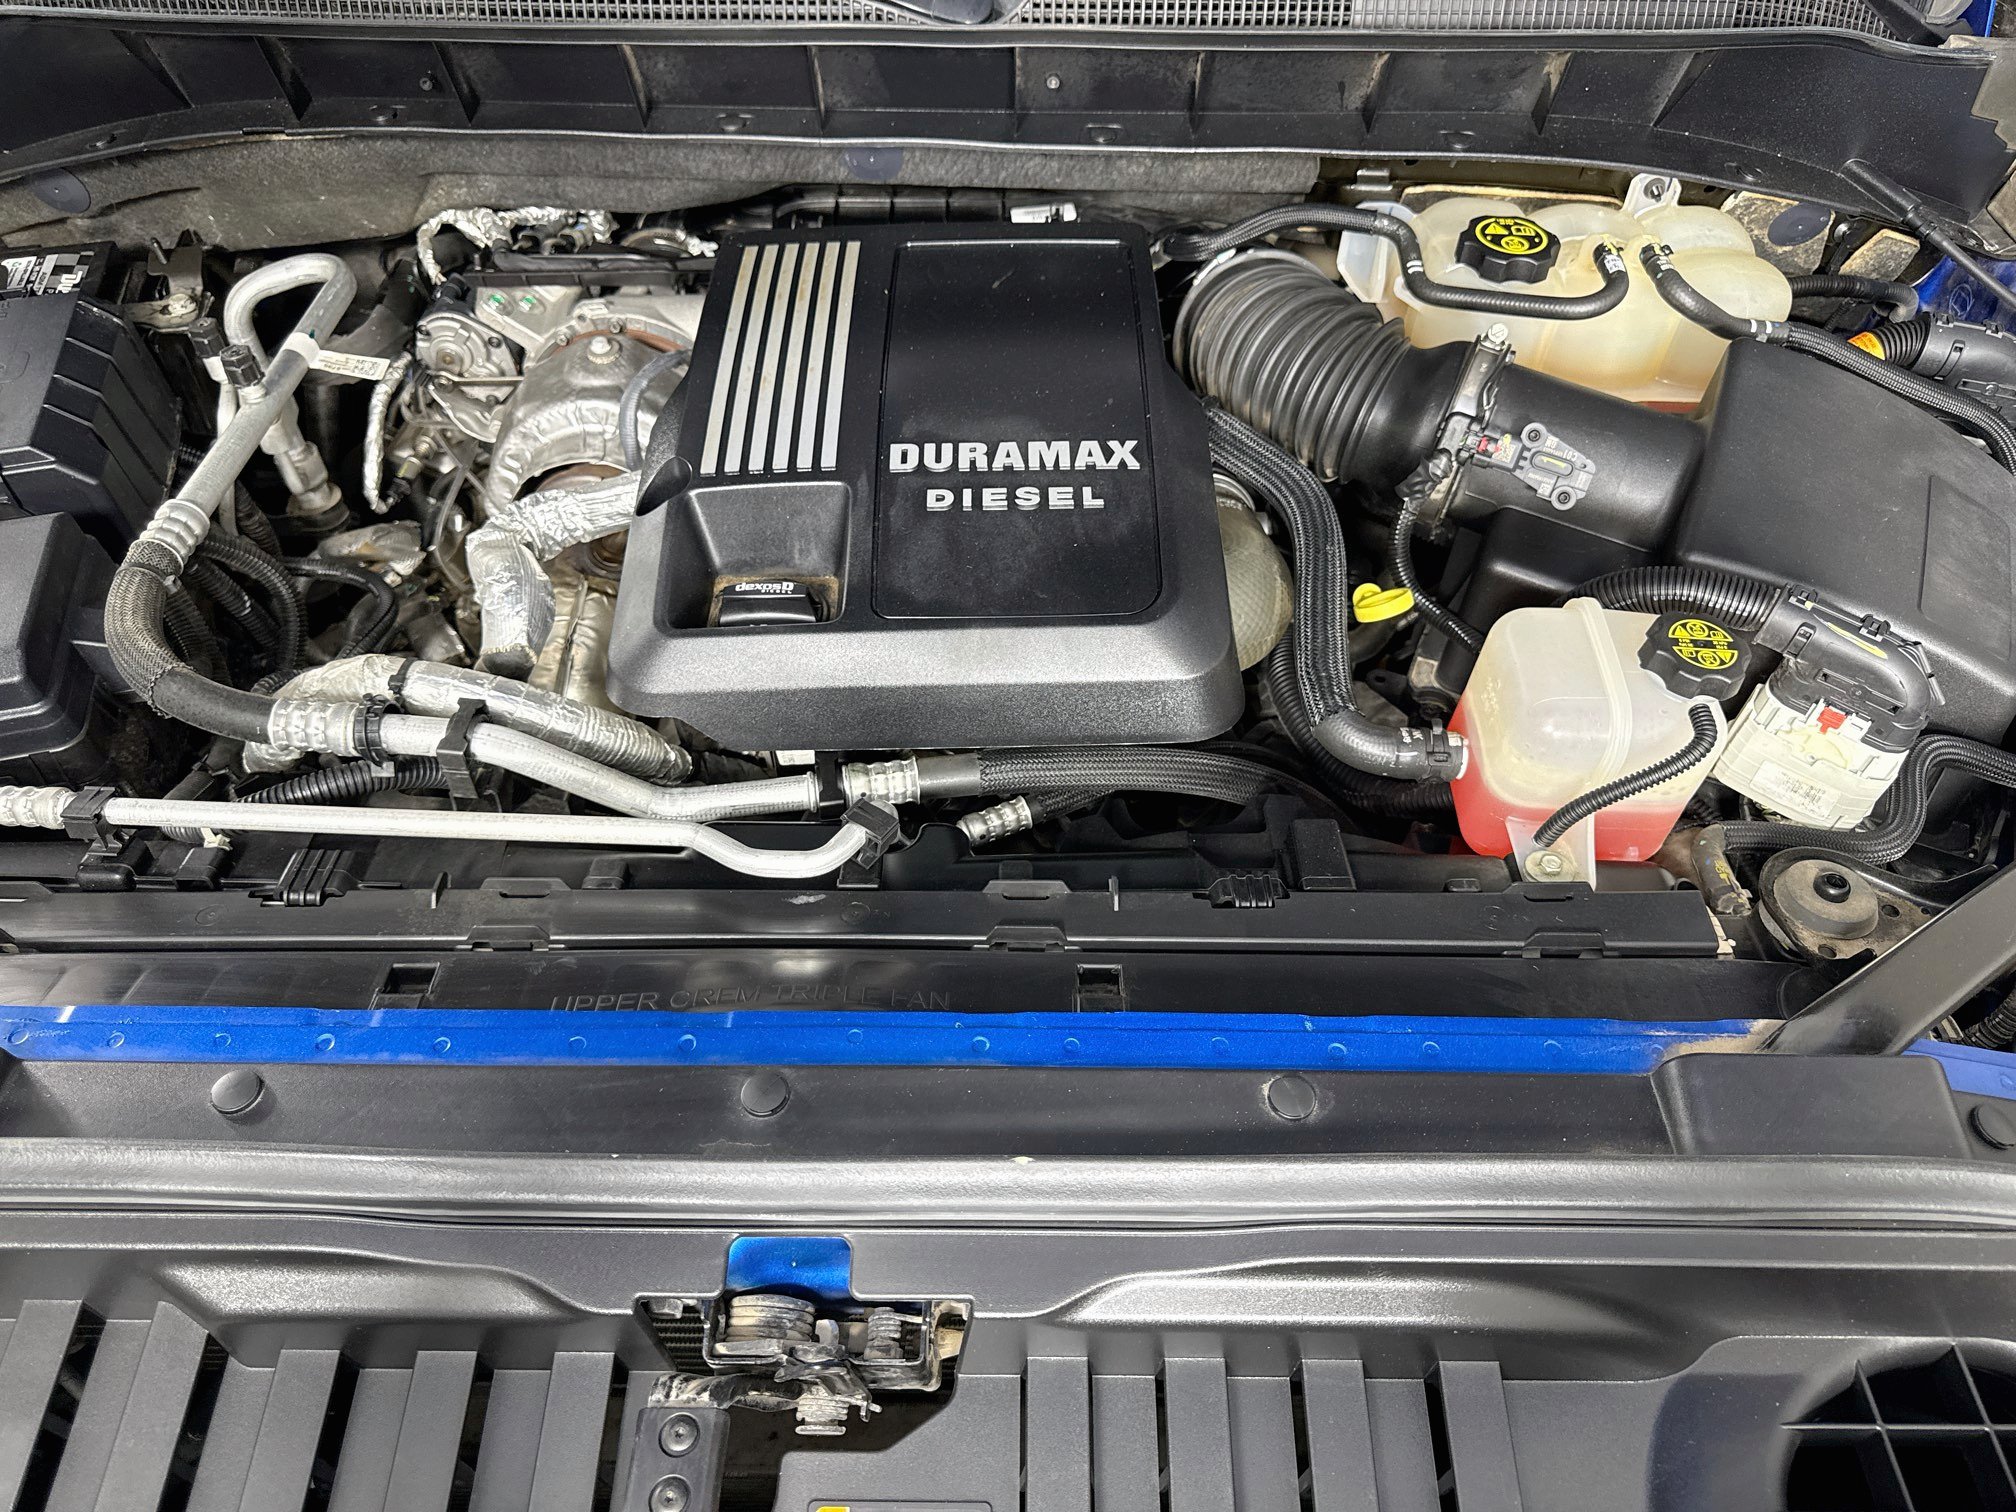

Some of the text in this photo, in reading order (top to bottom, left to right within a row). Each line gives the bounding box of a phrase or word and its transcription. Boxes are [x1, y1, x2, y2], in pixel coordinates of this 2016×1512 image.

[889, 441, 1141, 473] DURAMAX
[926, 486, 1105, 511] DIESEL
[550, 992, 660, 1012] UPPER
[772, 983, 881, 1006] TRIPLE
[890, 989, 950, 1011] FAN
